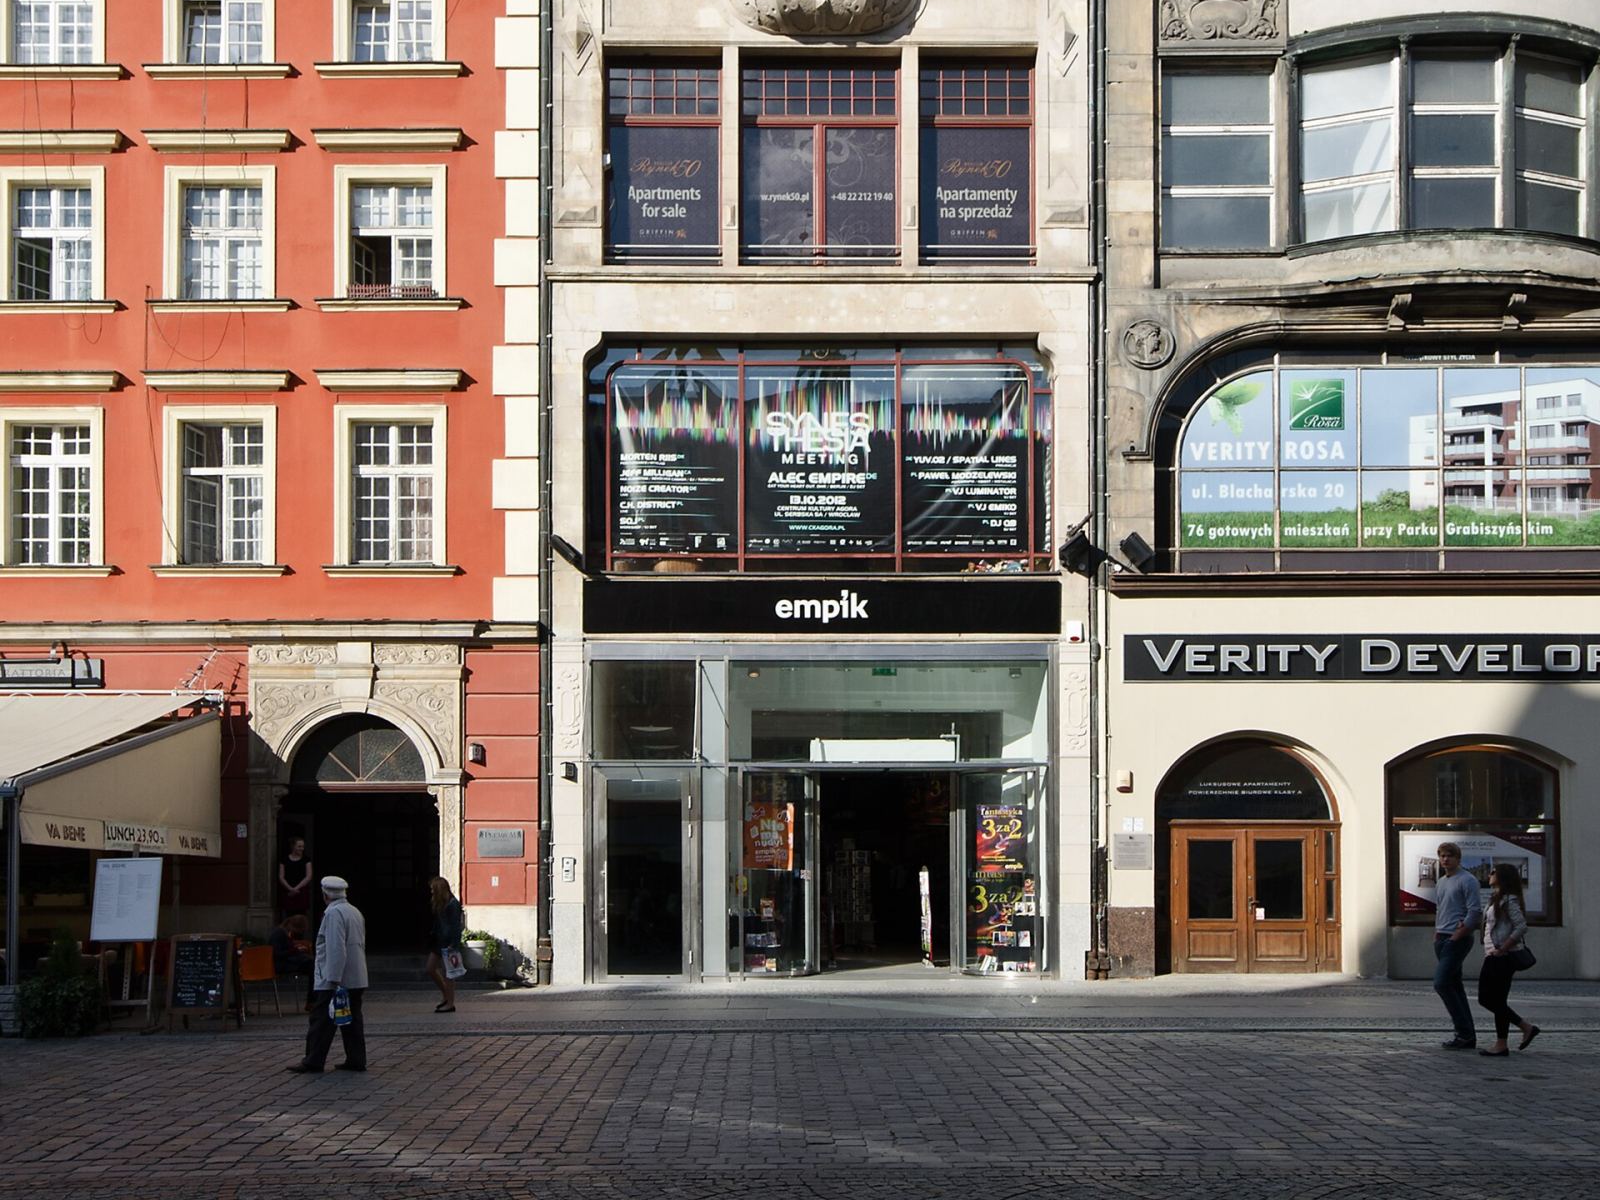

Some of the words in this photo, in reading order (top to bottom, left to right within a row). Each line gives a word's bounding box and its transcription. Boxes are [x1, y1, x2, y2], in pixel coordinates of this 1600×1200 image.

[628, 185, 701, 203] Apartments
[831, 192, 846, 201] +48
[847, 192, 857, 201] 22
[858, 192, 872, 201] 212
[873, 192, 882, 201] 19
[883, 192, 893, 201] 40
[936, 186, 1018, 204] Apartamenty
[641, 202, 660, 218] for
[661, 203, 687, 218] sale
[940, 207, 956, 218] na
[958, 203, 1013, 222] sprzedaż
[1303, 414, 1341, 428] Rosa
[1190, 441, 1270, 461] VERITY
[1284, 440, 1345, 460] ROSA
[781, 453, 859, 465] MEETING
[952, 455, 989, 464] SPATIAL
[767, 471, 805, 484] ALEC
[808, 472, 866, 484] EMPIRE
[866, 472, 877, 480] DE
[648, 485, 689, 494] CREATOR
[952, 487, 964, 496] VJ
[965, 487, 1017, 496] LUMINATOR
[1192, 483, 1213, 499] ul.
[1324, 483, 1344, 498] 20
[637, 501, 676, 509] DISTRICT
[789, 495, 846, 505] 13.10.2012
[975, 503, 987, 511] VJ
[990, 519, 1002, 527] DJ
[1187, 524, 1204, 537] 76
[1208, 524, 1272, 540] gotowych
[1284, 523, 1350, 537] mieszkań
[1363, 525, 1392, 539] przy
[1397, 523, 1438, 536] Parku
[1446, 521, 1553, 538] Grabiszyńskim
[774, 589, 869, 623] empik
[1142, 639, 1338, 672] VERITY
[45, 822, 60, 840] VA
[62, 824, 86, 842] BENE
[106, 825, 136, 842] LUNCH
[981, 819, 996, 840] 3
[996, 824, 1010, 832] za
[1008, 818, 1022, 839] 2
[178, 835, 190, 849] VA
[190, 836, 208, 851] BENE
